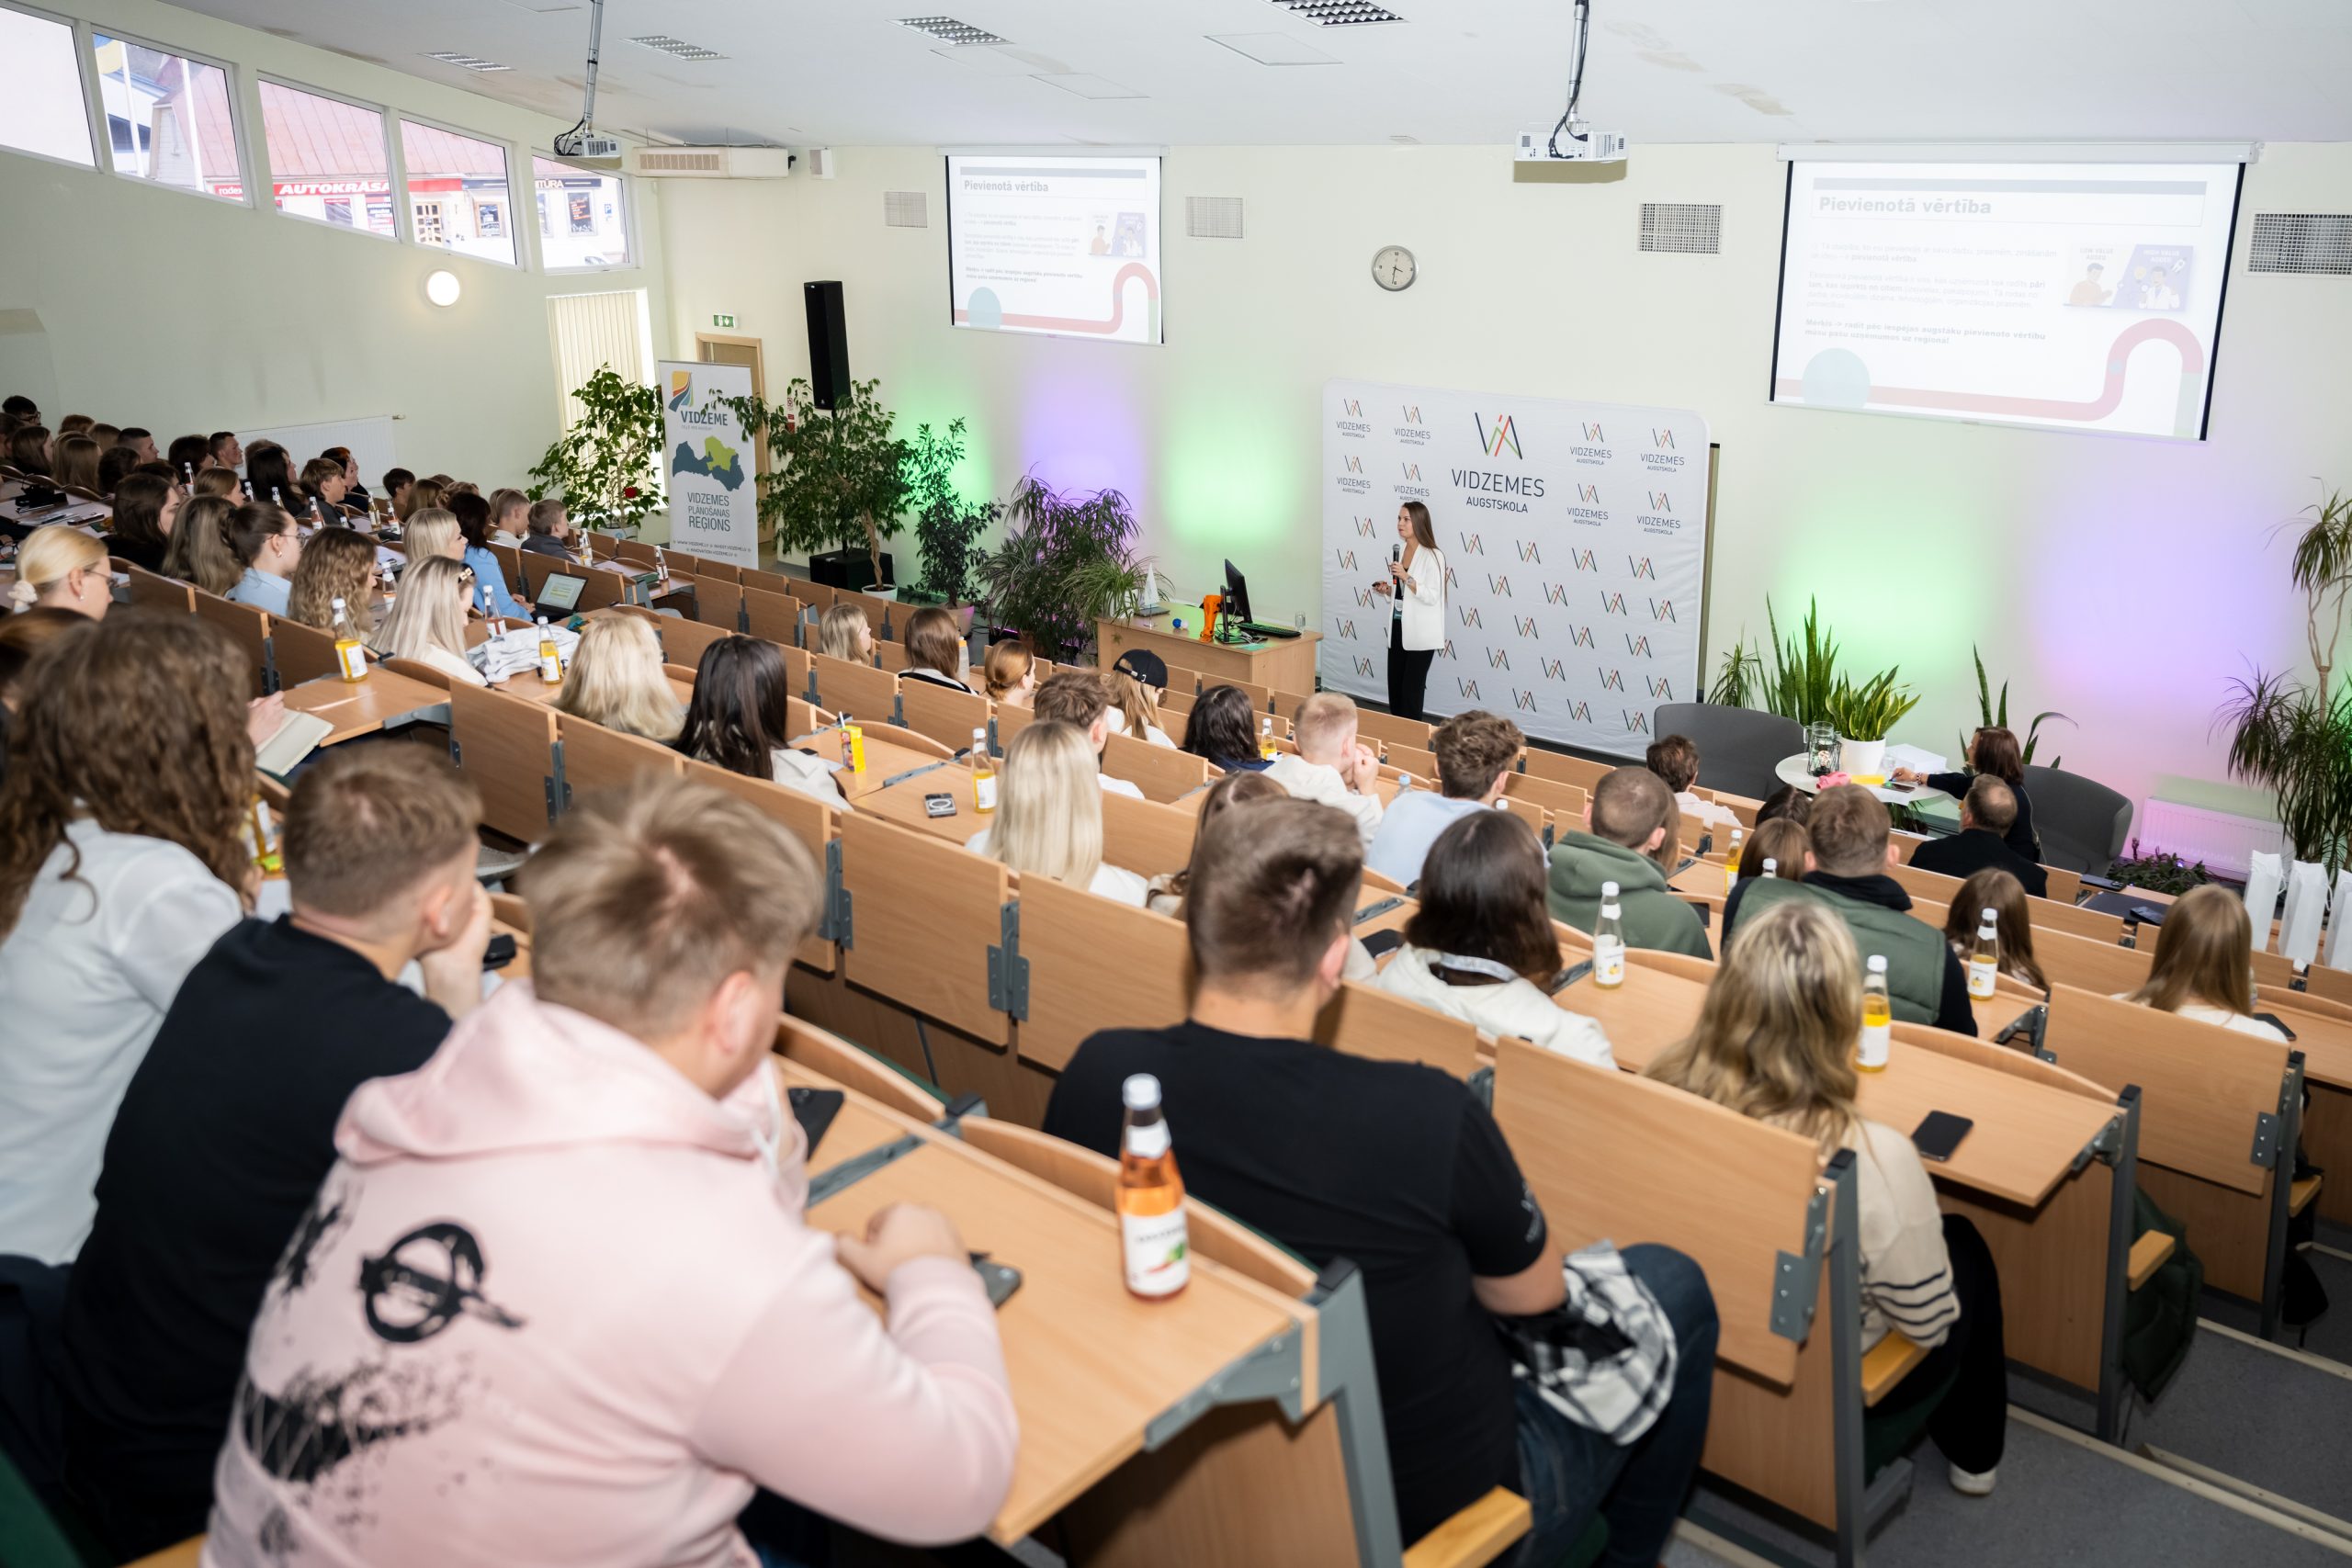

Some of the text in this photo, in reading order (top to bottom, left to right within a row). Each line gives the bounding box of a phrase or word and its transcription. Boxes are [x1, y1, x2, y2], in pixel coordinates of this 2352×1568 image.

[964, 179, 1049, 193] Pievienotā vērtība
[1819, 197, 1992, 214] Pievienotā vērtība
[681, 411, 728, 426] VIDZEME
[1336, 422, 1371, 433] VIDZEMES
[1394, 428, 1431, 440] VIDZEMES
[1569, 446, 1612, 459] VIDZEMES
[1640, 453, 1685, 467] VIDZEMES
[1336, 477, 1371, 490] VIDZEMES
[1452, 468, 1545, 498] VIDZEMES
[1394, 484, 1430, 498] VIDZEMES
[687, 491, 729, 506] VIDZEMES
[1465, 496, 1529, 513] AUGSTSKOLA
[688, 505, 730, 518] PLĀNOŠANAS
[1566, 507, 1609, 521] VIDZEMES
[689, 515, 730, 532] REĢIONS
[1636, 515, 1681, 530] VIDZEMES
